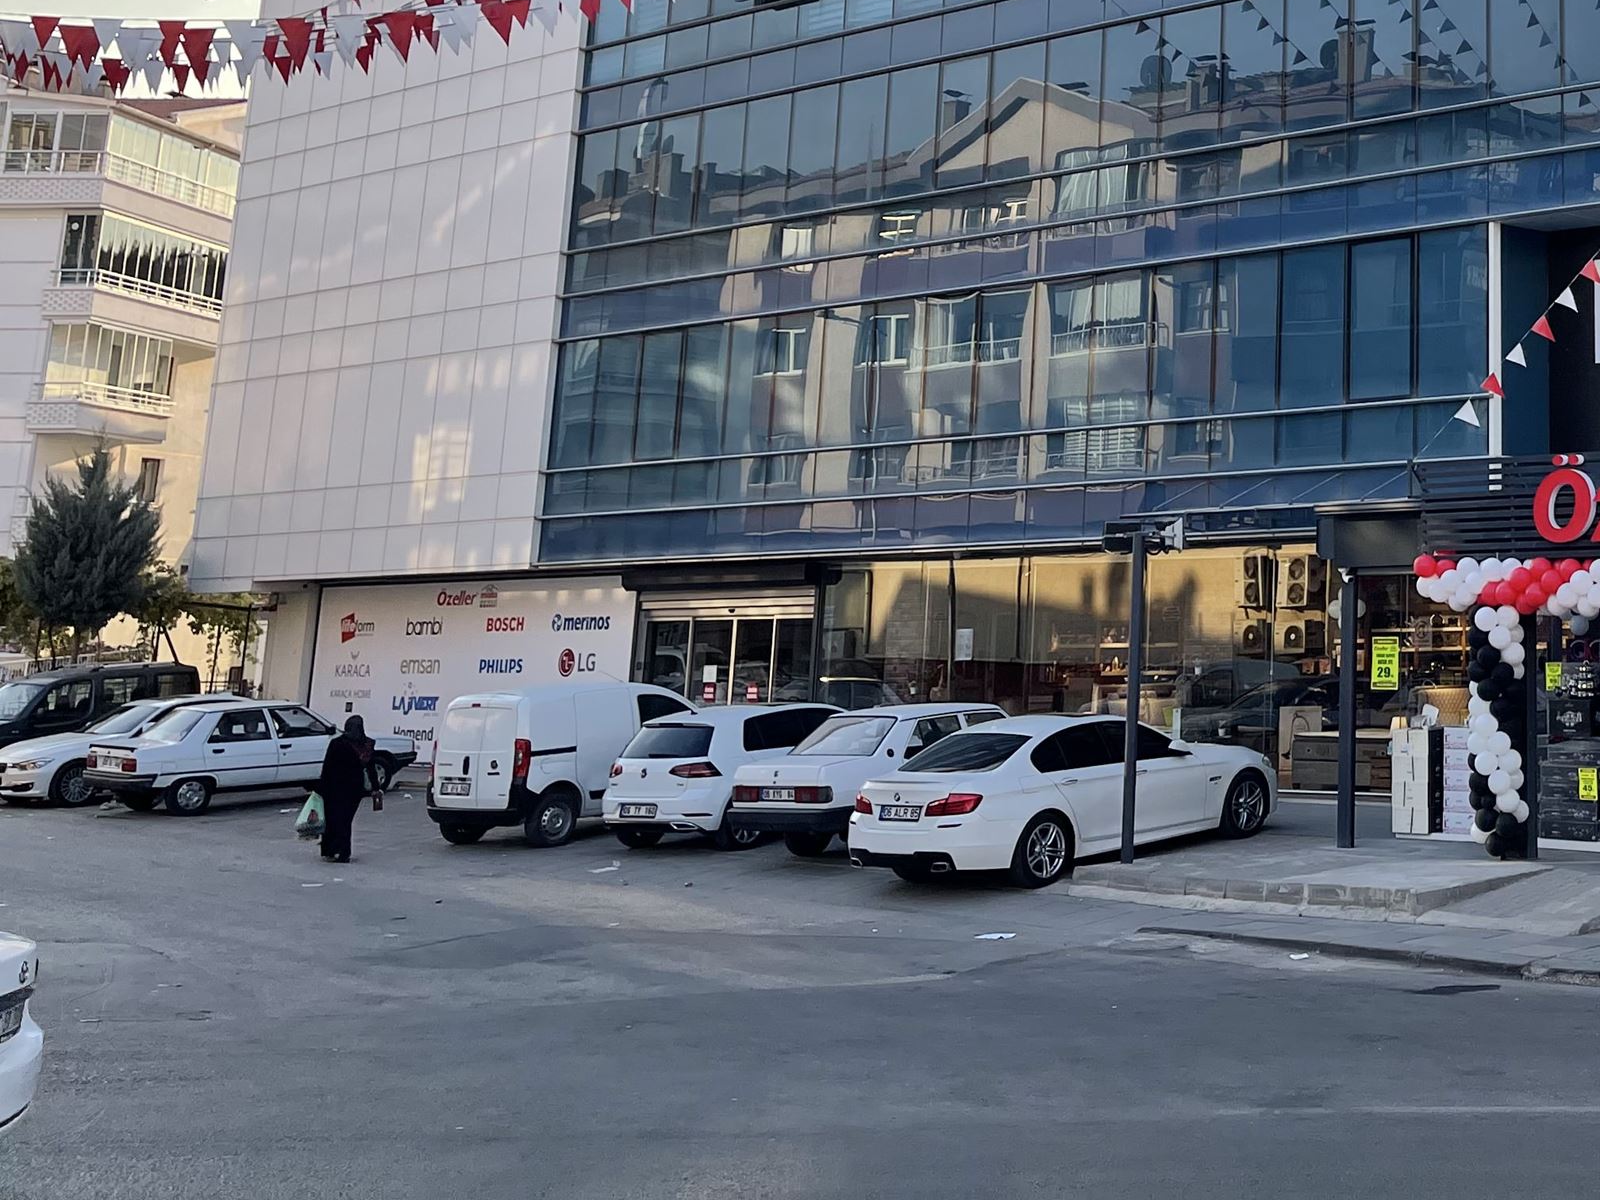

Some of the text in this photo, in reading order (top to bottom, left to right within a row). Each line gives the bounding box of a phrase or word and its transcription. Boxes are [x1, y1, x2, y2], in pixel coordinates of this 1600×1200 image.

[437, 588, 477, 606] Özeller
[406, 616, 443, 636] bambi
[486, 617, 525, 632] BOSCH
[563, 615, 610, 631] merinos
[400, 658, 441, 674] emsan
[478, 658, 523, 674] PHILIPS
[577, 653, 597, 672] LG
[334, 664, 371, 678] KARACA
[882, 807, 919, 818] 06 ALR 85
